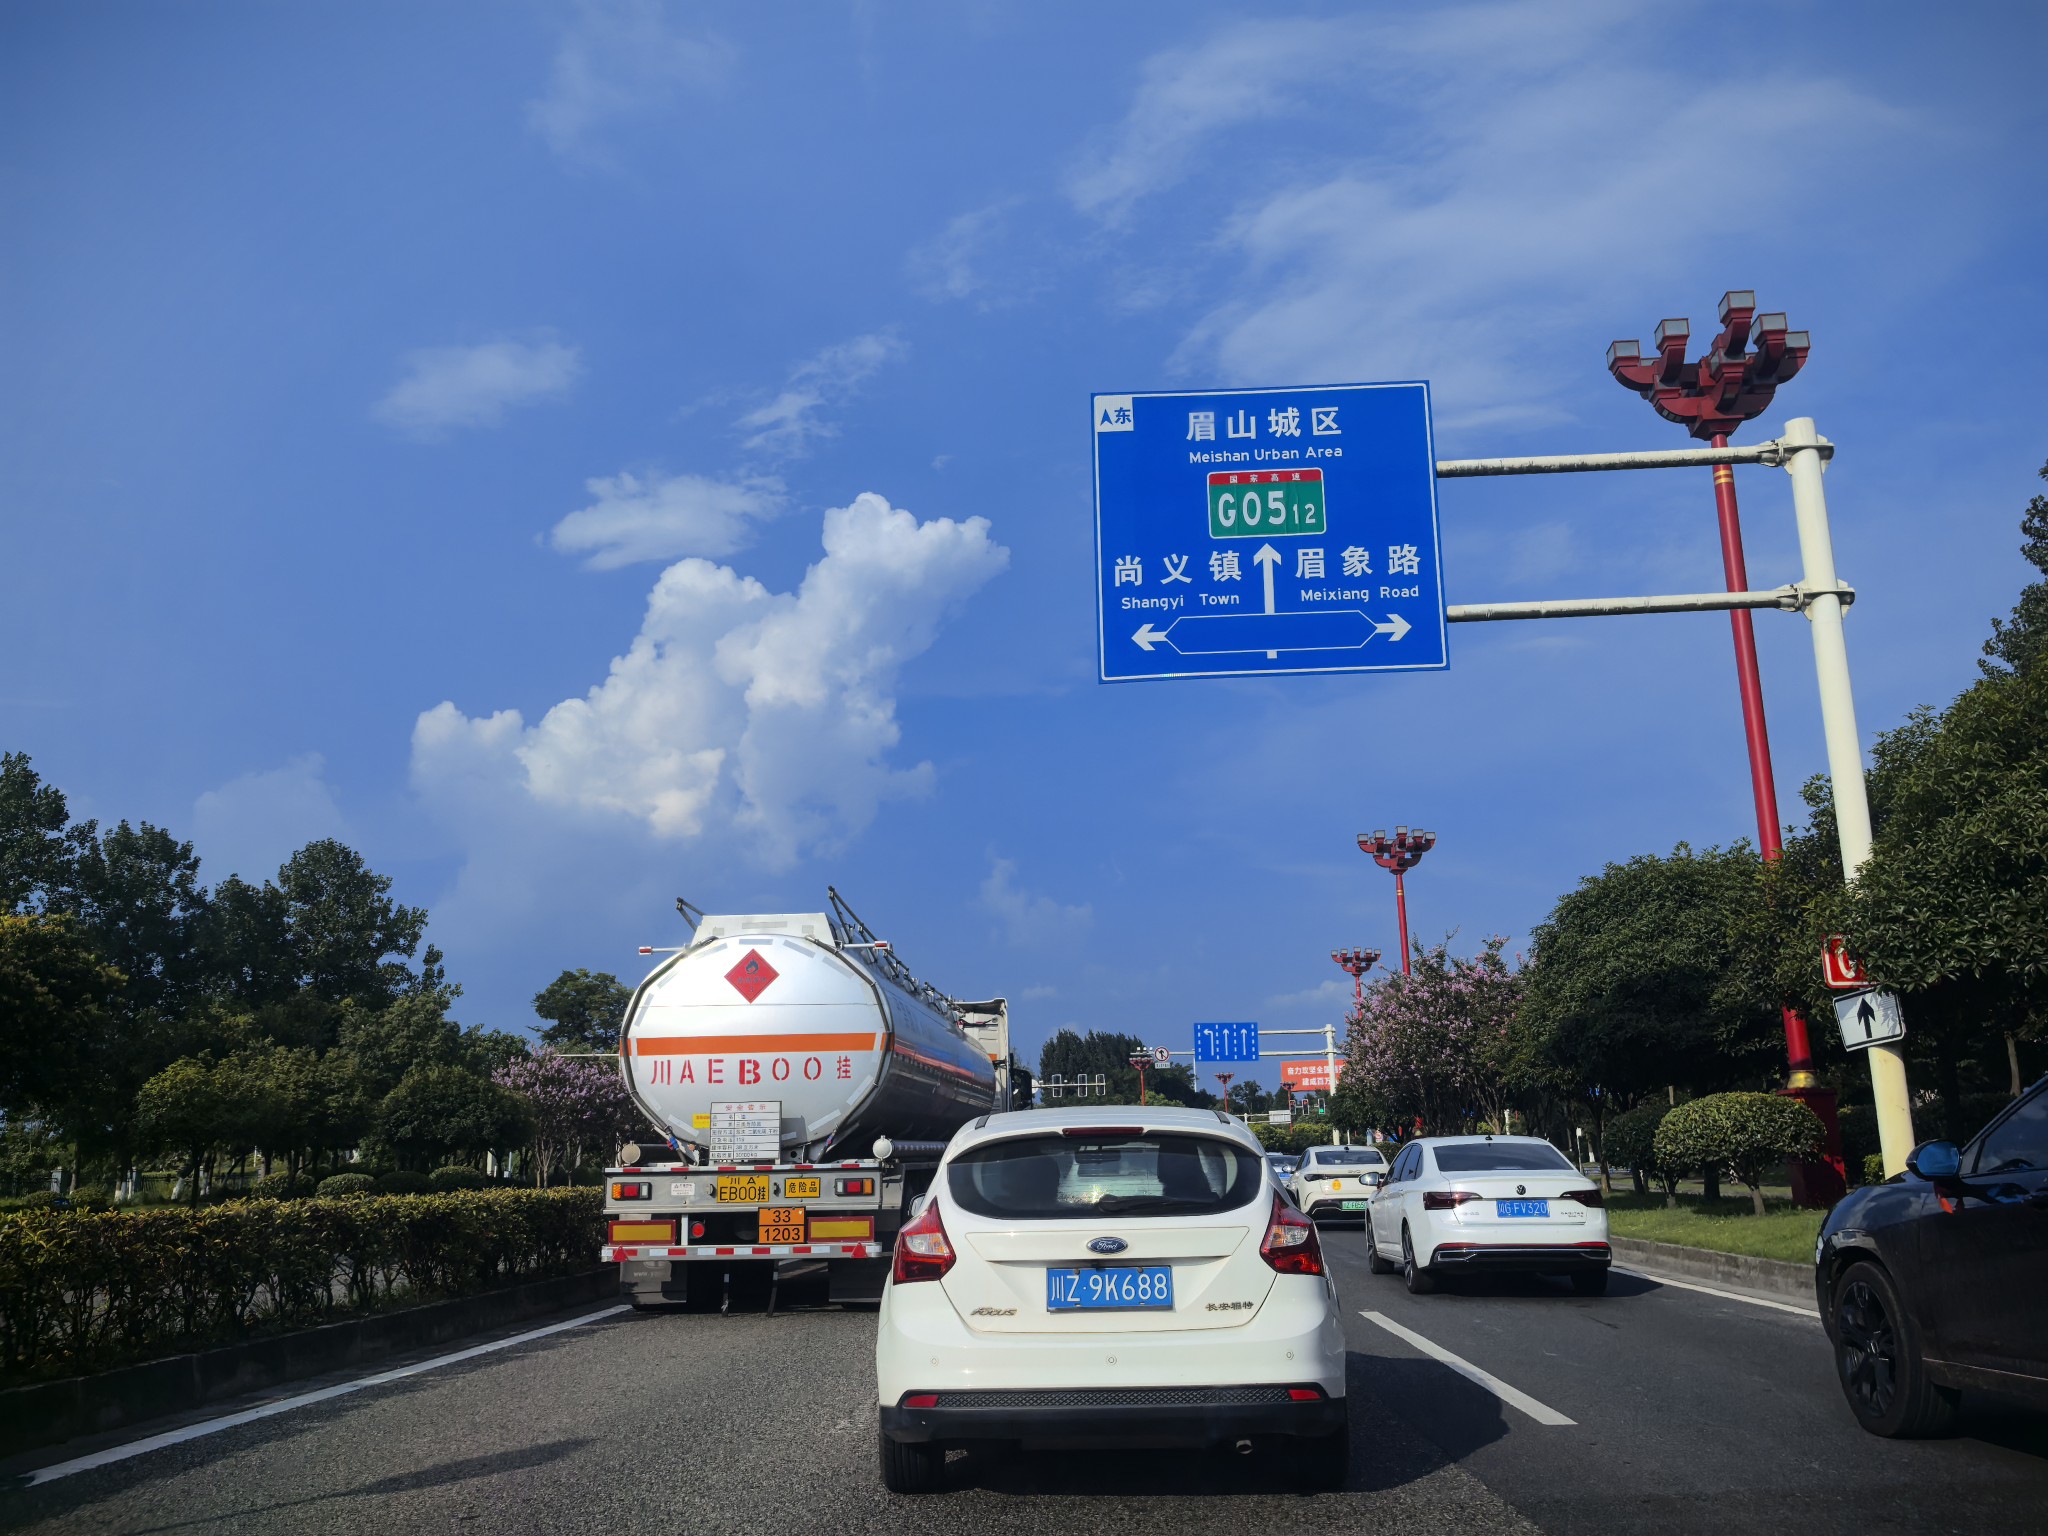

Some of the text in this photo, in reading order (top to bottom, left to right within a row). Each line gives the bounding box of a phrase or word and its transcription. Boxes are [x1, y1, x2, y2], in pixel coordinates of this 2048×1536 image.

[1114, 406, 1131, 424] 东
[1186, 407, 1342, 441] 眉山城区
[1189, 446, 1343, 464] Meishan Urban Area
[1229, 472, 1301, 484] 国家高速
[1218, 490, 1316, 527] G0512
[1114, 550, 1242, 587] 尚义镇
[1295, 543, 1421, 579] 眉象路
[1121, 593, 1240, 611] Shangyi Town
[1300, 585, 1419, 602] Meixiang Road
[730, 1177, 756, 1185] 川A
[789, 1181, 818, 1193] 危险品
[719, 1186, 766, 1201] EB00挂
[773, 1209, 791, 1223] 33
[764, 1227, 801, 1242] 1203
